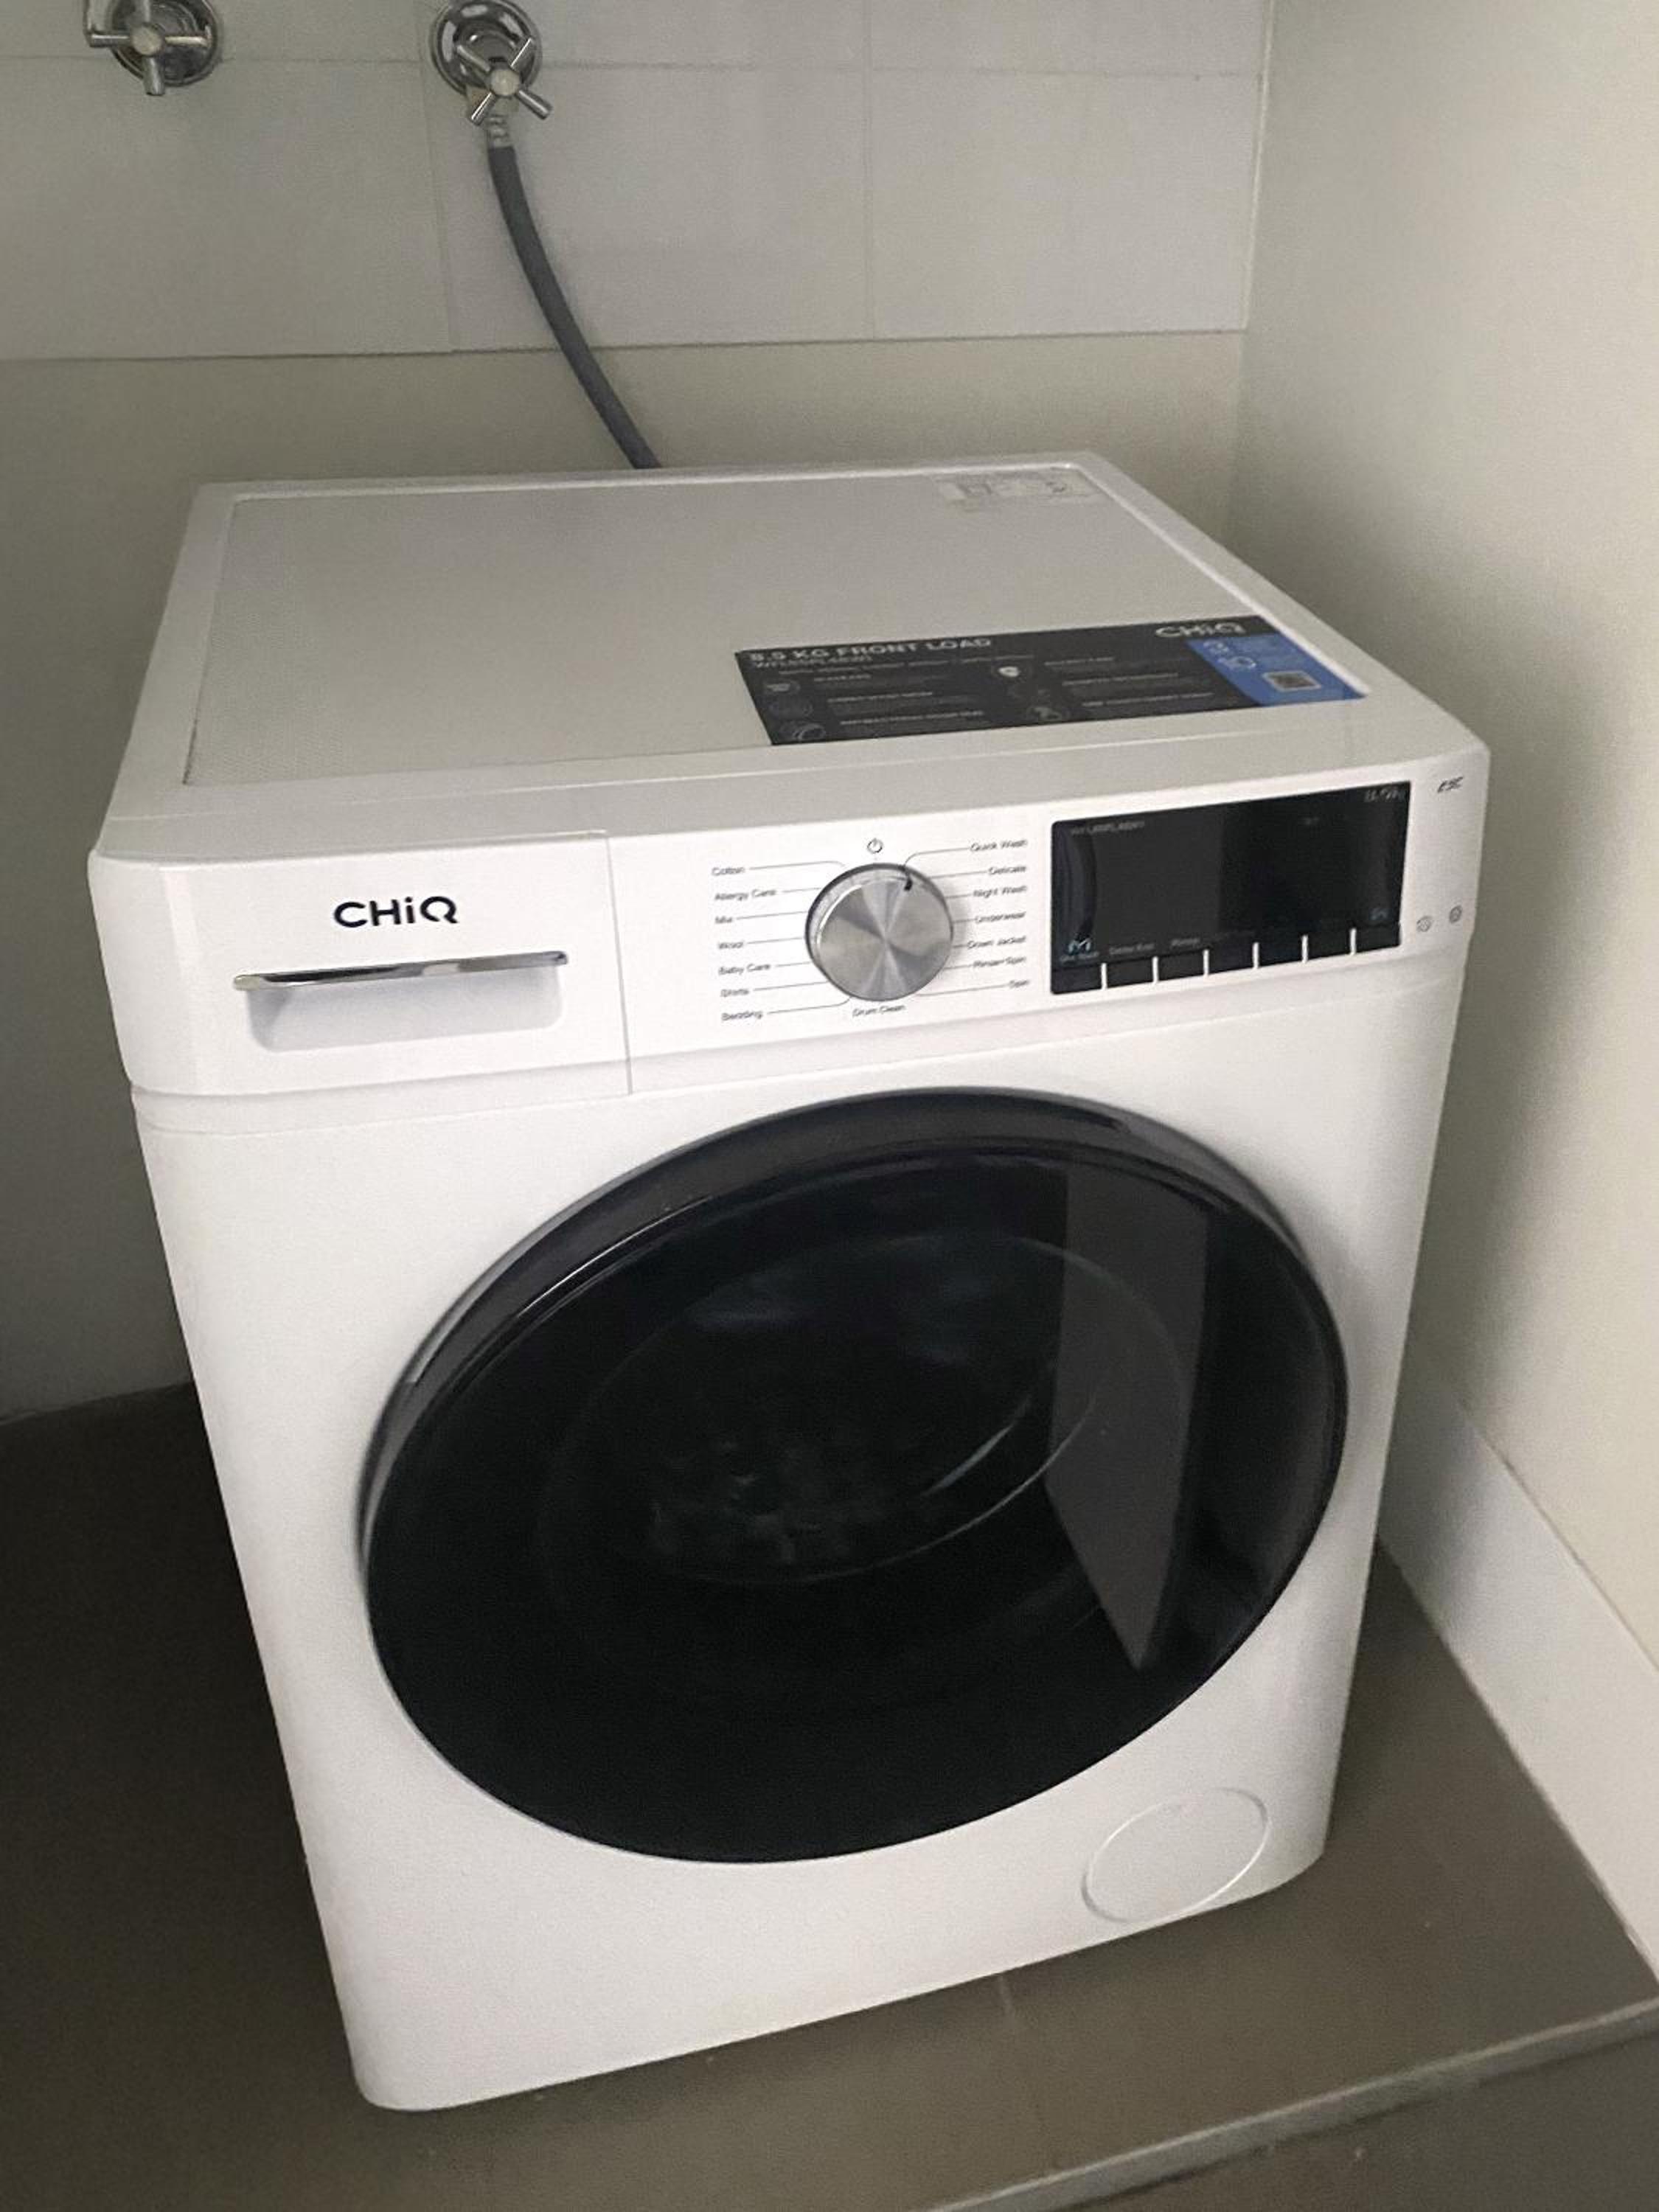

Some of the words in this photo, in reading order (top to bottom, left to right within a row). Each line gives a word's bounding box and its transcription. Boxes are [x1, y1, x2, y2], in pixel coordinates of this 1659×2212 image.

[1155, 622, 1247, 638] CHiQ
[792, 648, 830, 659] KG
[835, 642, 917, 656] FRONT
[925, 637, 992, 651] LOAD
[970, 842, 997, 852] Quick
[1001, 839, 1028, 849] Wash
[712, 866, 745, 876] Cotton
[987, 866, 1027, 876] Delicate
[714, 892, 749, 902] Allergy
[751, 888, 776, 898] Care
[973, 888, 998, 899] Night
[1001, 885, 1027, 896] Wash
[333, 894, 459, 929] CHiQ
[718, 966, 745, 975] Baby
[746, 963, 771, 973] Care
[852, 1007, 877, 1018] Drum
[879, 1005, 906, 1015] Clean
